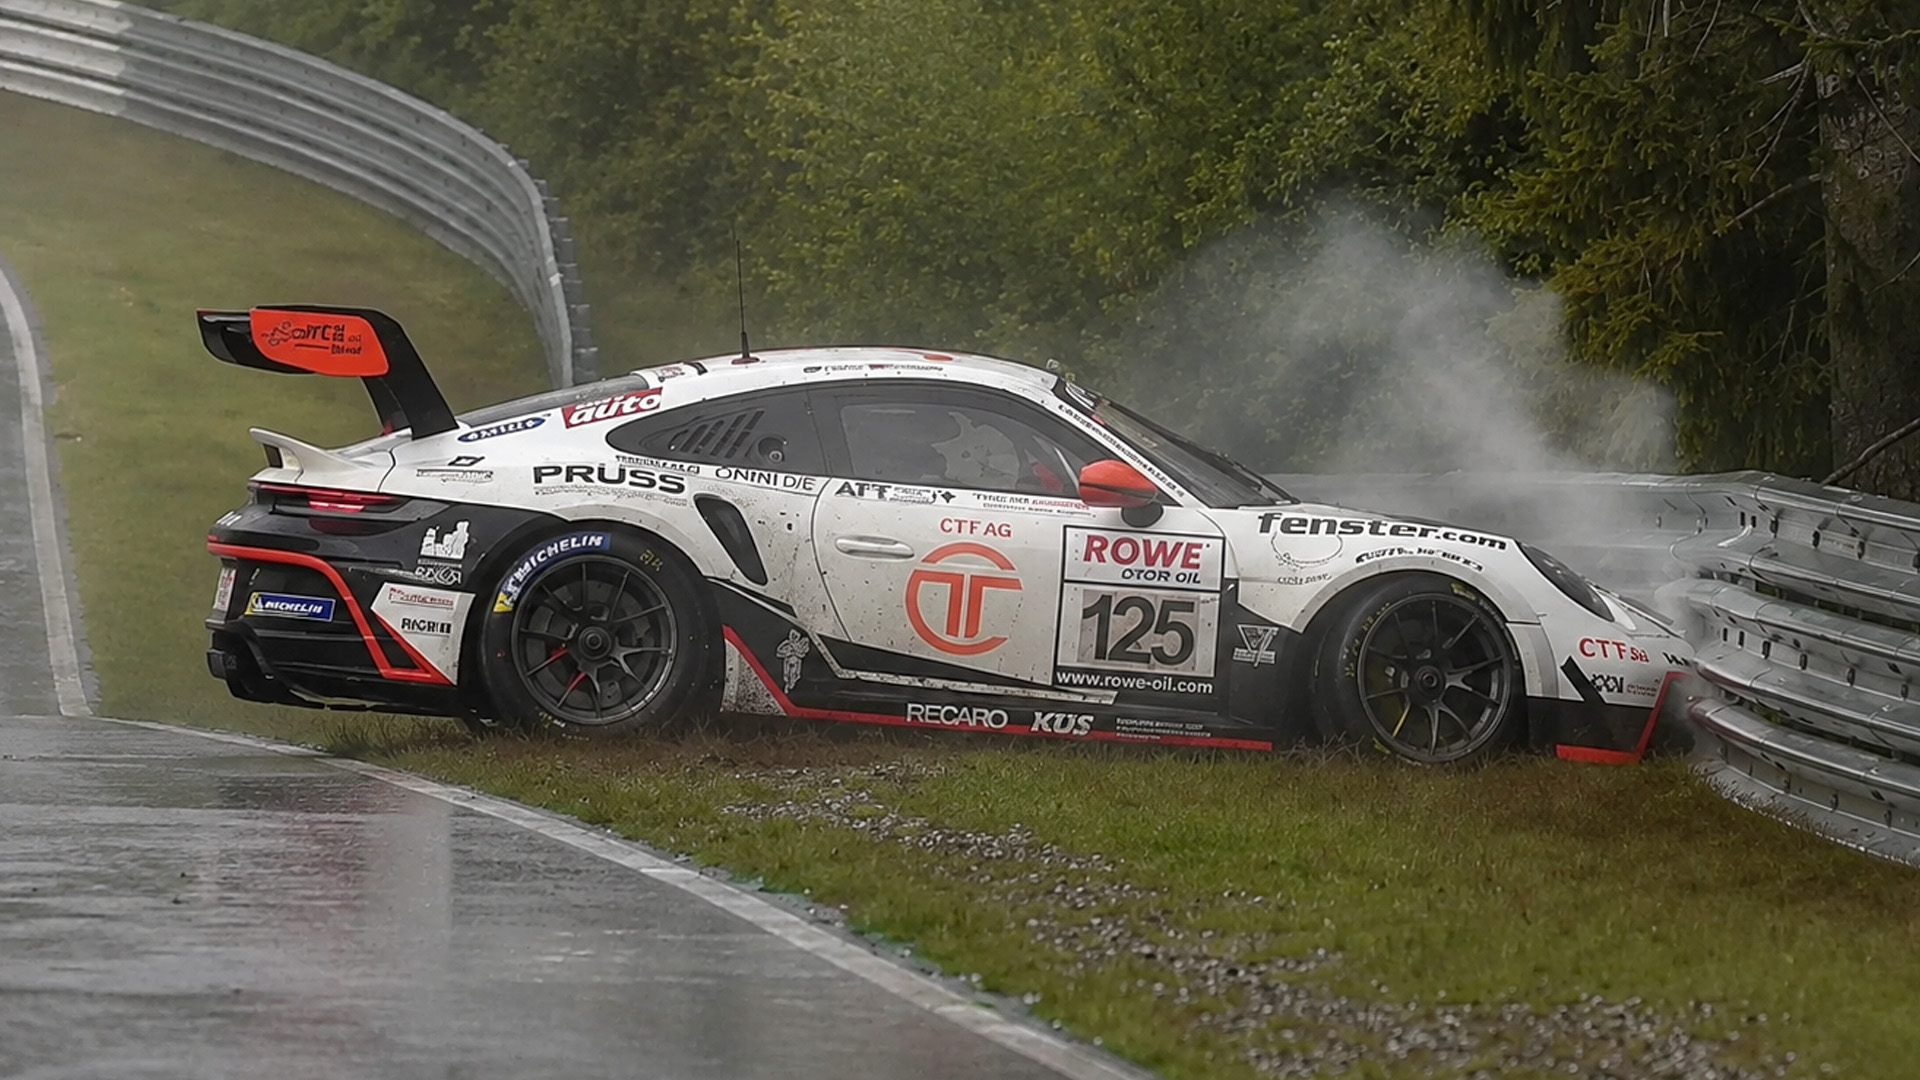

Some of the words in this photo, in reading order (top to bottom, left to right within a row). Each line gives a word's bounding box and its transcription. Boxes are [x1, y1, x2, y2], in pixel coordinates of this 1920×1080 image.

[569, 394, 661, 425] auto
[1258, 513, 1507, 550] fenster.com
[1083, 534, 1203, 569] ROWE
[1175, 572, 1201, 584] OIL
[1082, 594, 1195, 666] 125
[1056, 671, 1213, 694] www.rowe-oil.com
[906, 703, 1008, 729] RECARO
